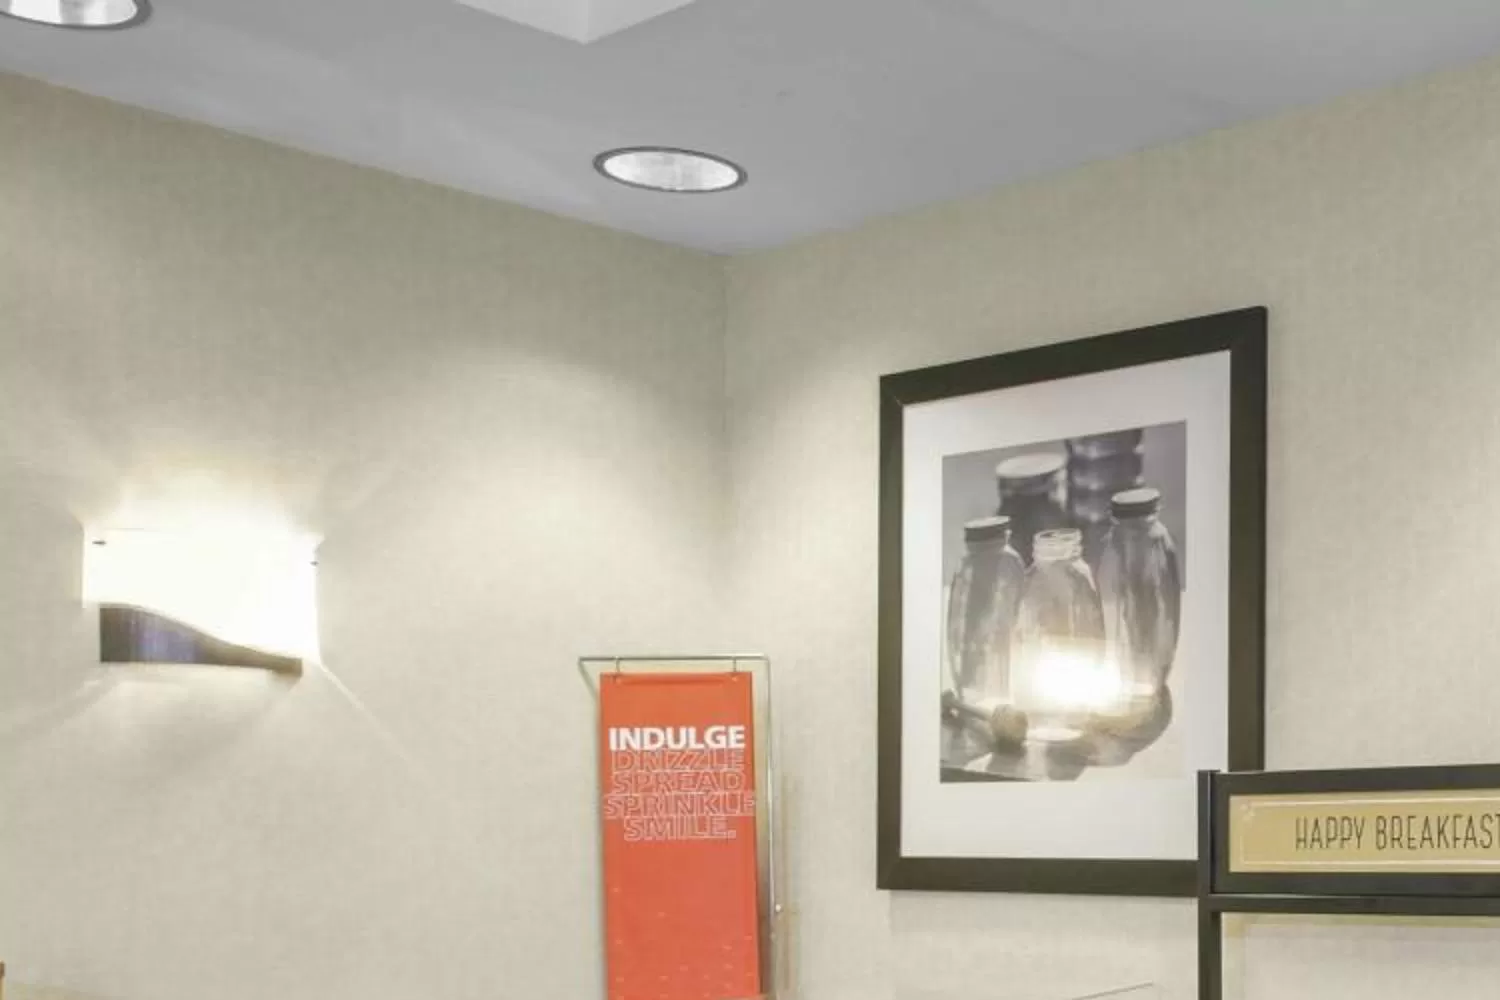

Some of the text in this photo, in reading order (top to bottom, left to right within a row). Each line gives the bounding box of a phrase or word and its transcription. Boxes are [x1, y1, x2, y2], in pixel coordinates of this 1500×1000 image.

[608, 725, 747, 751] INDULGE
[612, 749, 746, 772] DRIZZLE
[612, 769, 746, 797] SPREAD
[1295, 814, 1366, 851] HAPPY
